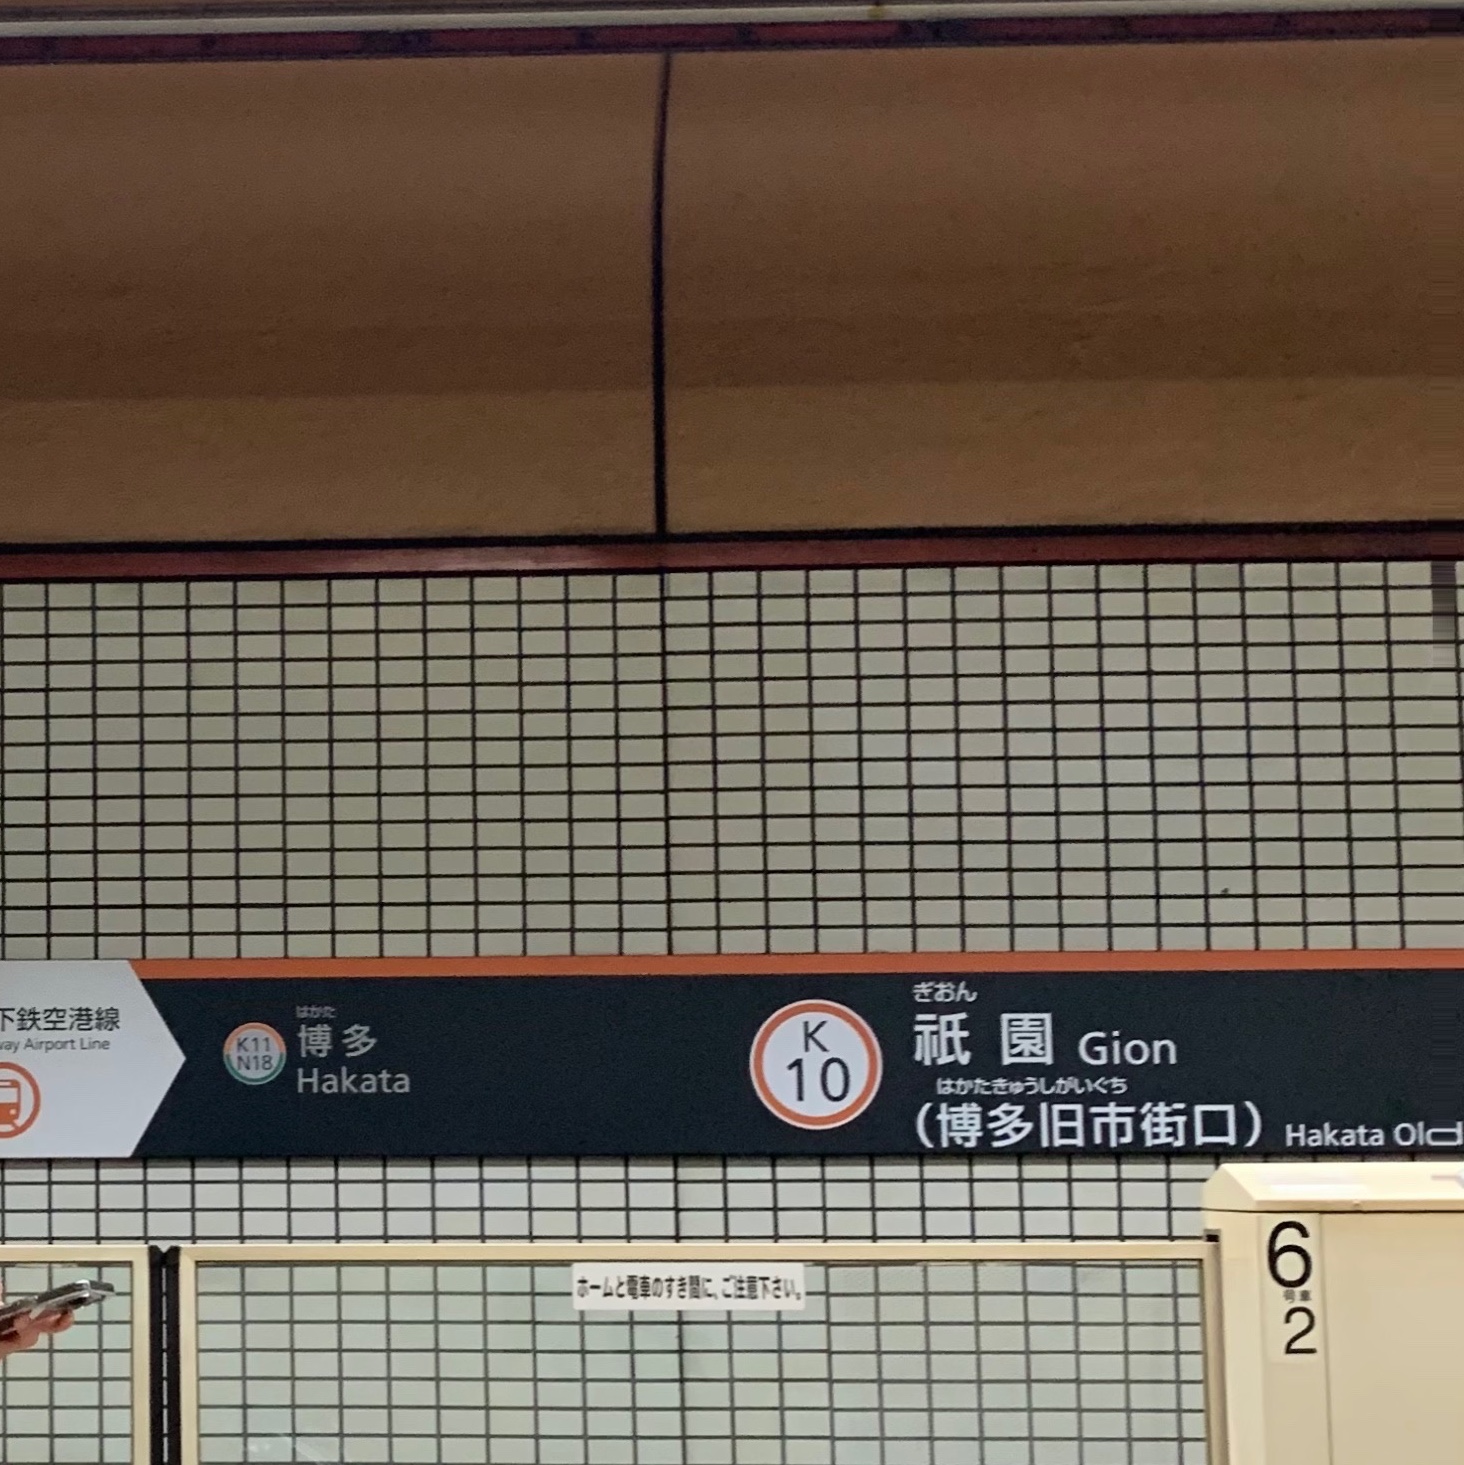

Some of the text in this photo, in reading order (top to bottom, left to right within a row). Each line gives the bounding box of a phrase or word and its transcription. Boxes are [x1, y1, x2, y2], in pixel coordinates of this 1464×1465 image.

[912, 980, 978, 1003] ぎおん
[23, 1037, 77, 1056] Airport
[79, 1037, 111, 1051] Line
[236, 1036, 272, 1053] K11
[297, 1024, 378, 1058] 博多
[802, 1020, 828, 1053] K
[1078, 1030, 1177, 1066] Gion
[236, 1055, 274, 1072] N18
[297, 1067, 411, 1094] Hakata
[786, 1056, 851, 1101] 10
[936, 1076, 1128, 1096] はかたきゅうしがいぐち
[1285, 1121, 1385, 1147] Hakata
[1267, 1220, 1312, 1288] 6
[1284, 1306, 1318, 1355] 2
